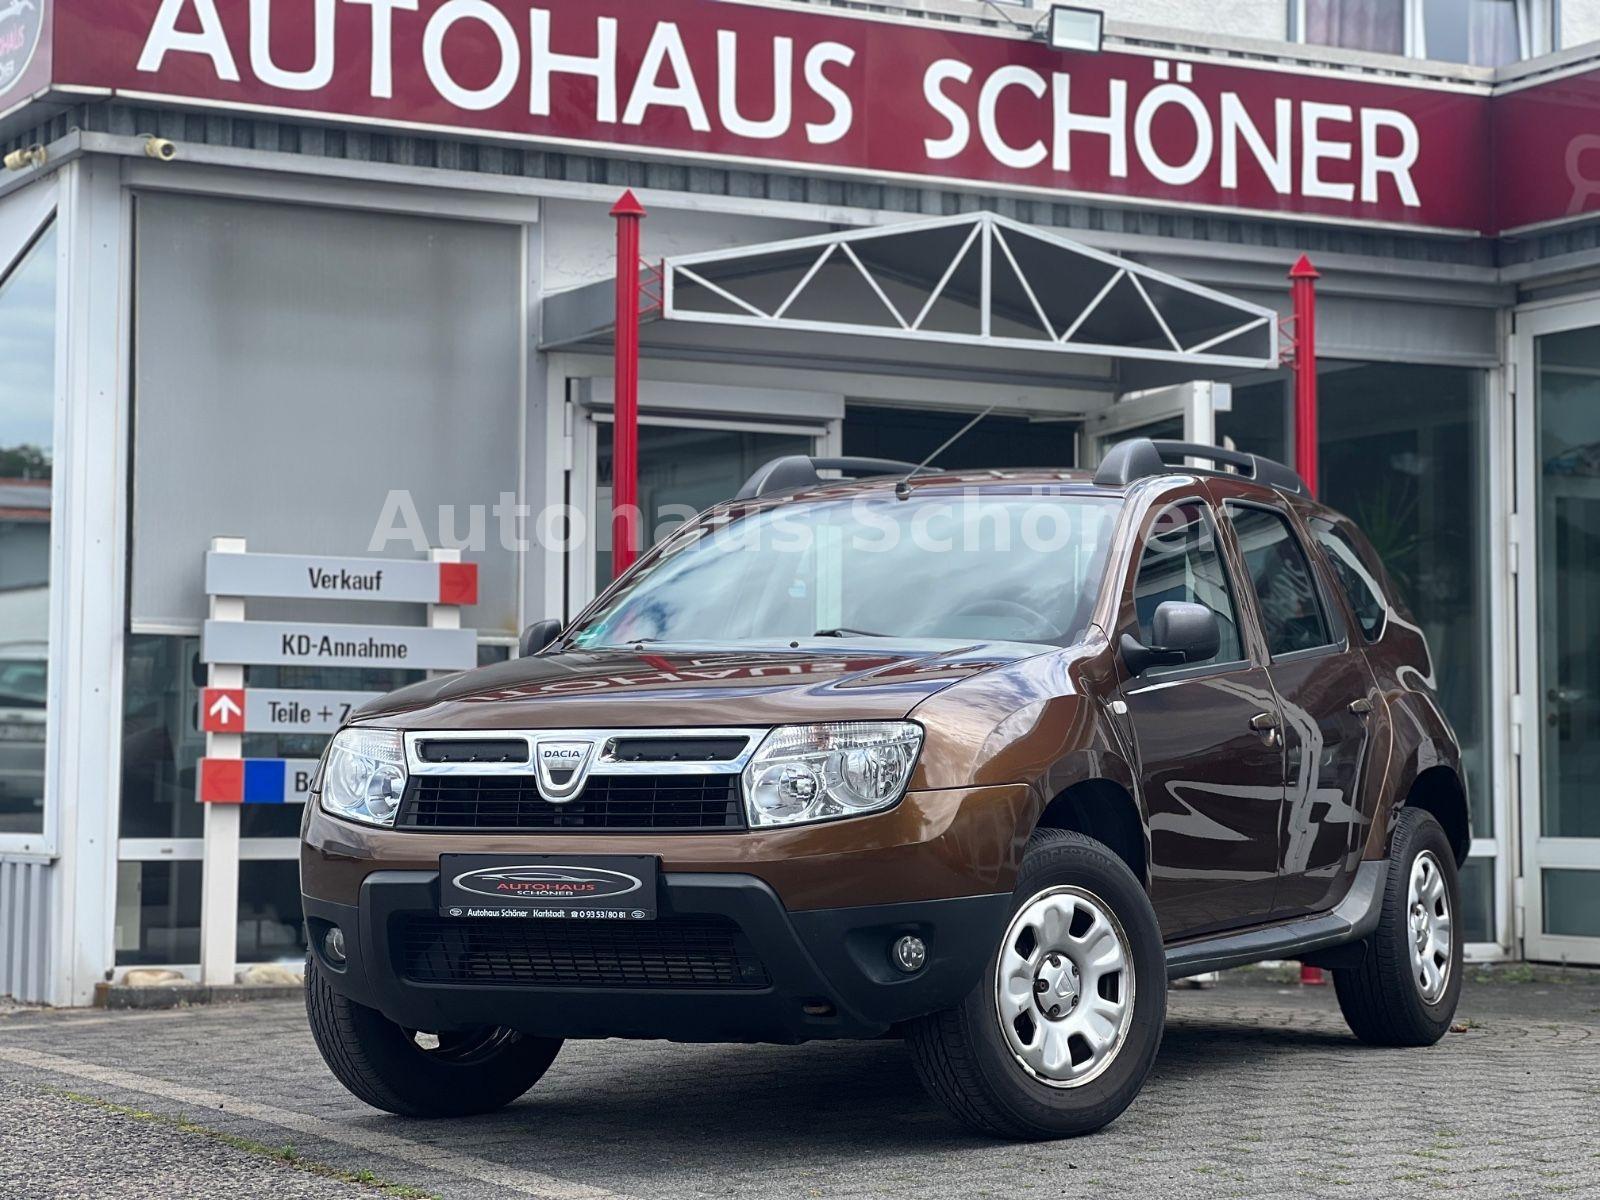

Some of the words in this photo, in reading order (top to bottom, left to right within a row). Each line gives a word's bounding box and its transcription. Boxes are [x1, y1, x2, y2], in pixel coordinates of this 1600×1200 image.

[136, 0, 855, 146] AUTOHAUS
[922, 59, 1422, 207] SCHÖNER
[308, 567, 383, 591] Verkauf
[282, 634, 408, 659] KD-Annahme
[268, 702, 311, 724] Teile
[317, 706, 333, 722] +
[340, 703, 356, 724] Z
[544, 750, 580, 758] DACIA
[295, 771, 313, 792] B
[496, 883, 595, 891] AUTOHAUS
[467, 908, 500, 917] Autohaus
[501, 908, 528, 917] Schöner
[533, 909, 565, 918] Karlstadt
